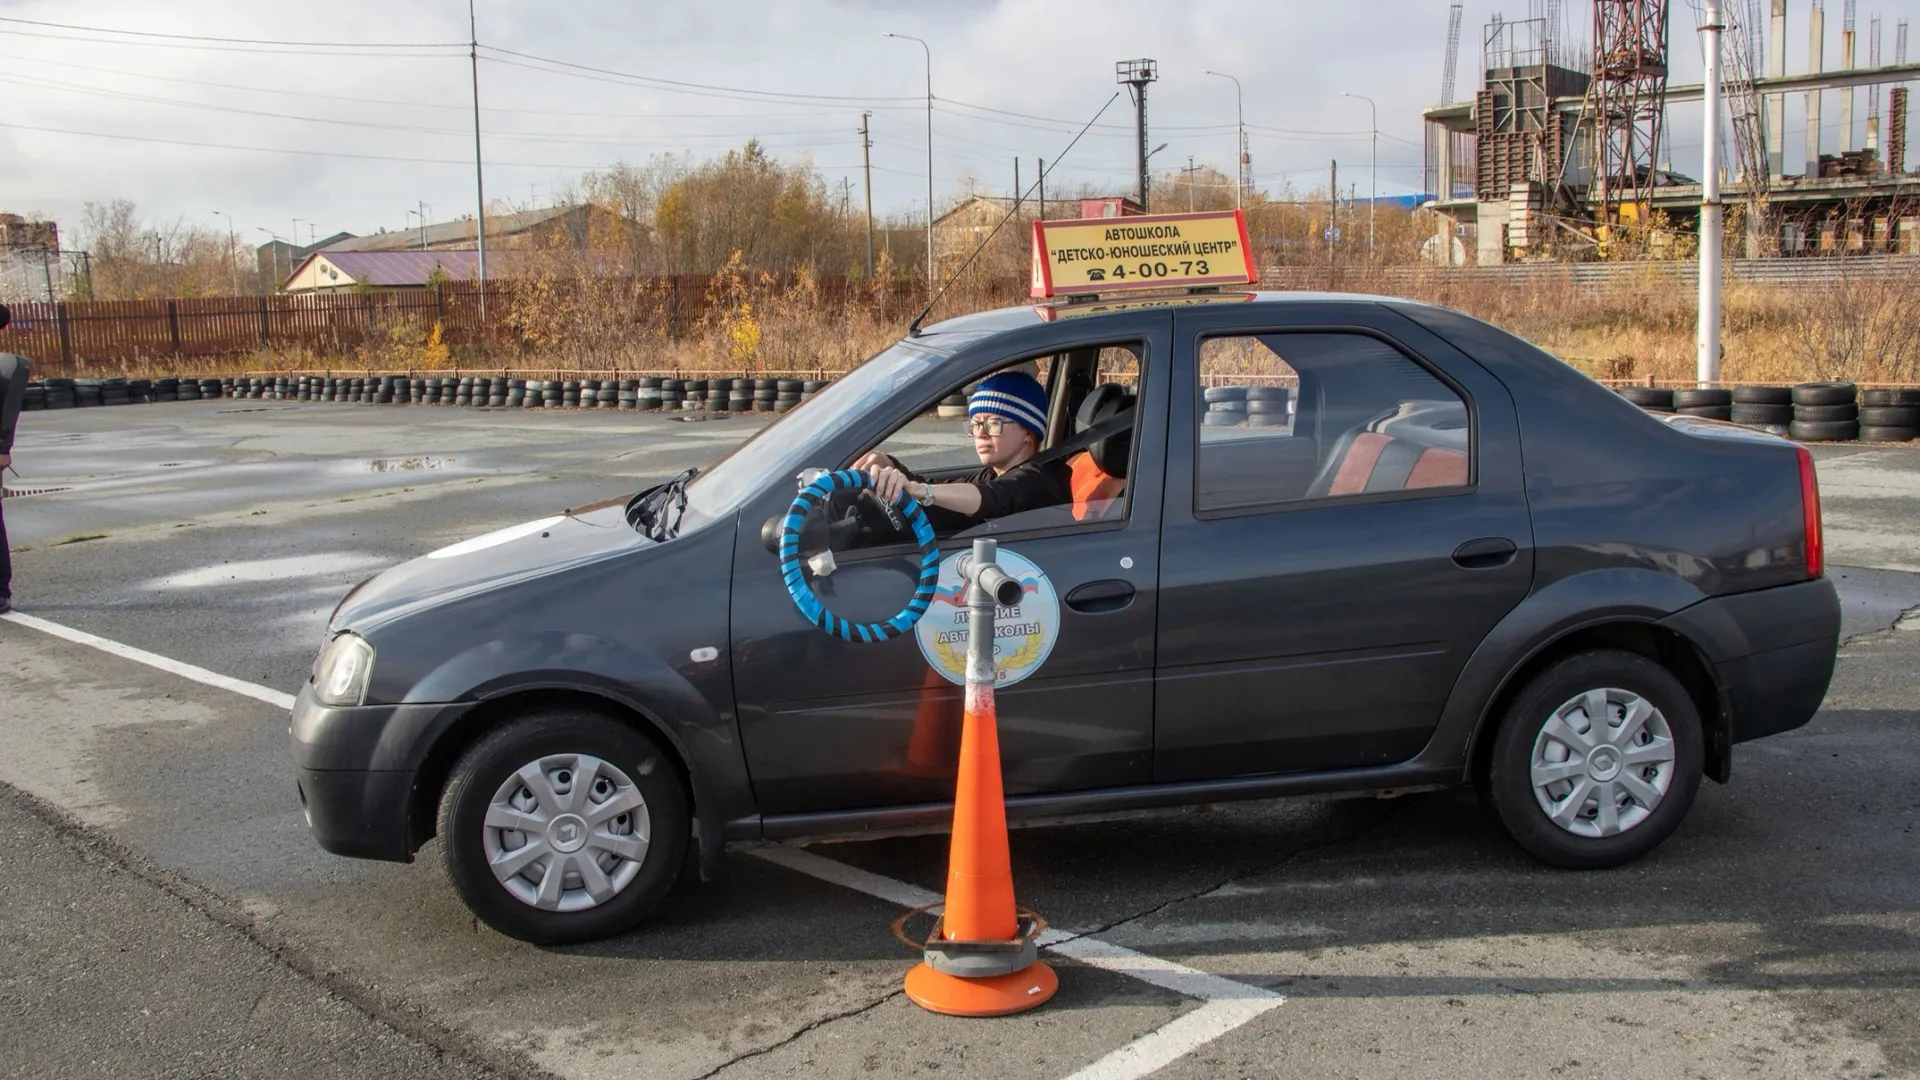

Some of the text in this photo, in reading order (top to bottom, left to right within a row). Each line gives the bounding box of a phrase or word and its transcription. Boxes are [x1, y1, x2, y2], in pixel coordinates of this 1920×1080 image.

[1105, 225, 1181, 241] АВТОШКОЛА
[1112, 260, 1210, 279] 4-00-73
[954, 606, 1021, 624] ЛИЕ
[938, 622, 1041, 644] АВТКОЛЫ
